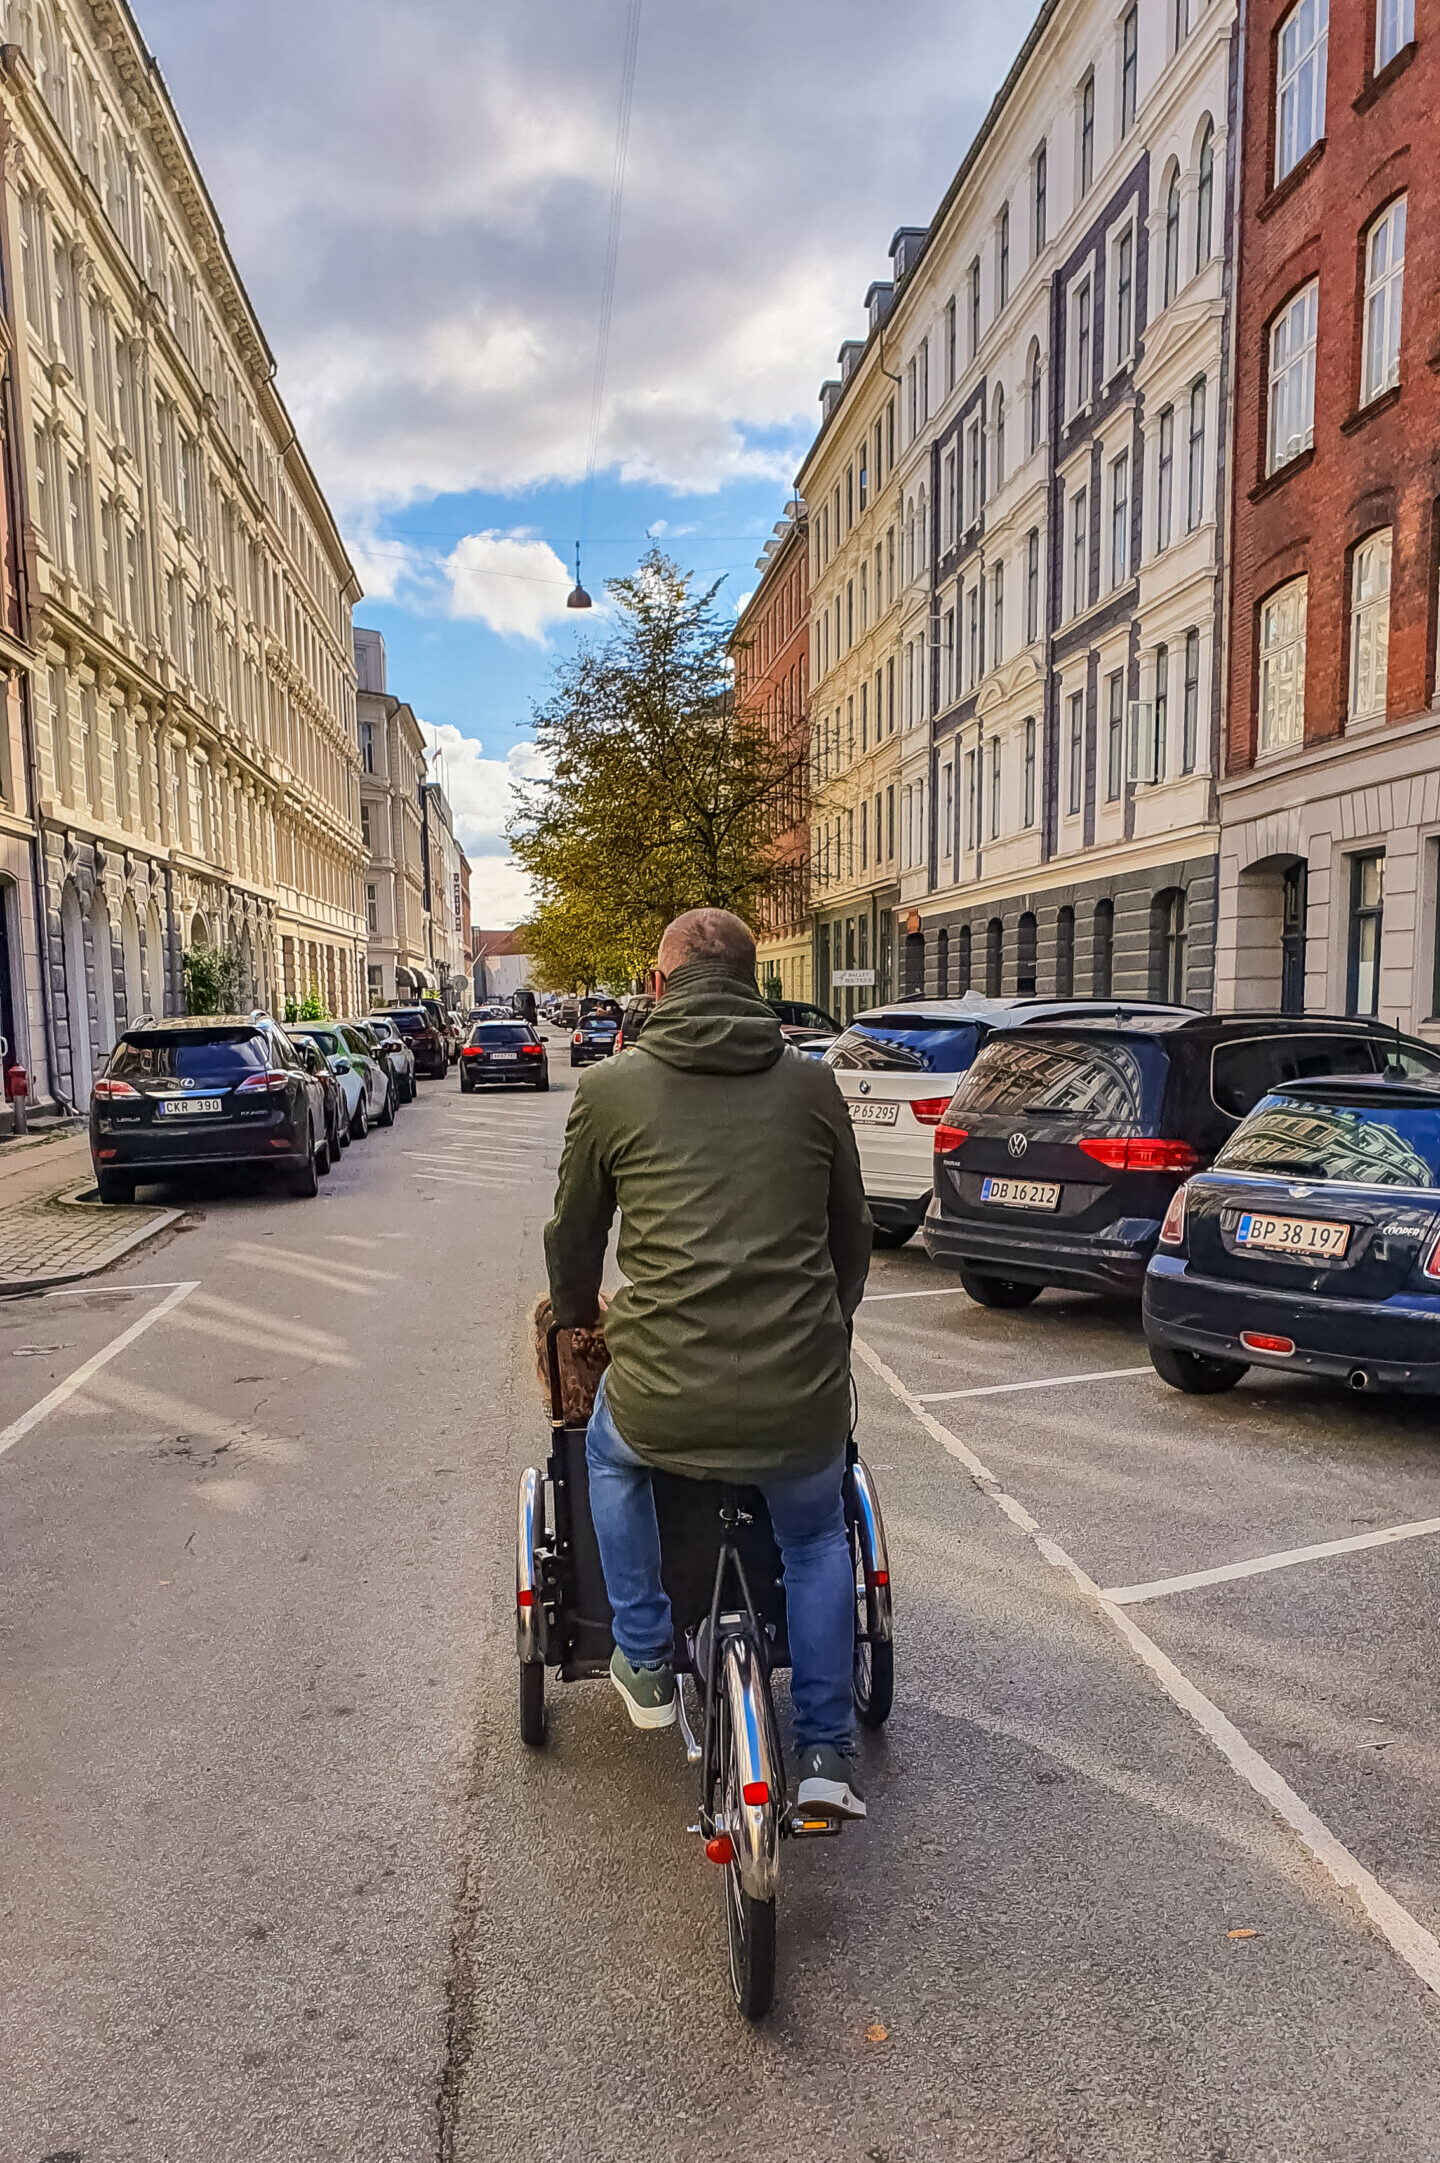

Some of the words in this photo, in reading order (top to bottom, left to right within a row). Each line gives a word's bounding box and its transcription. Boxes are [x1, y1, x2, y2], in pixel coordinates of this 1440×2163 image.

[166, 1101, 188, 1113] CKR
[197, 1100, 220, 1112] 390
[862, 1105, 875, 1118] 65
[875, 1106, 895, 1119] 295
[990, 1182, 1009, 1198] DB
[1011, 1184, 1027, 1200] 16
[1029, 1186, 1056, 1203] 212
[1250, 1219, 1276, 1240] BP
[1278, 1223, 1303, 1244] 38
[1308, 1227, 1345, 1249] 197
[1382, 1225, 1420, 1237] COOPER
